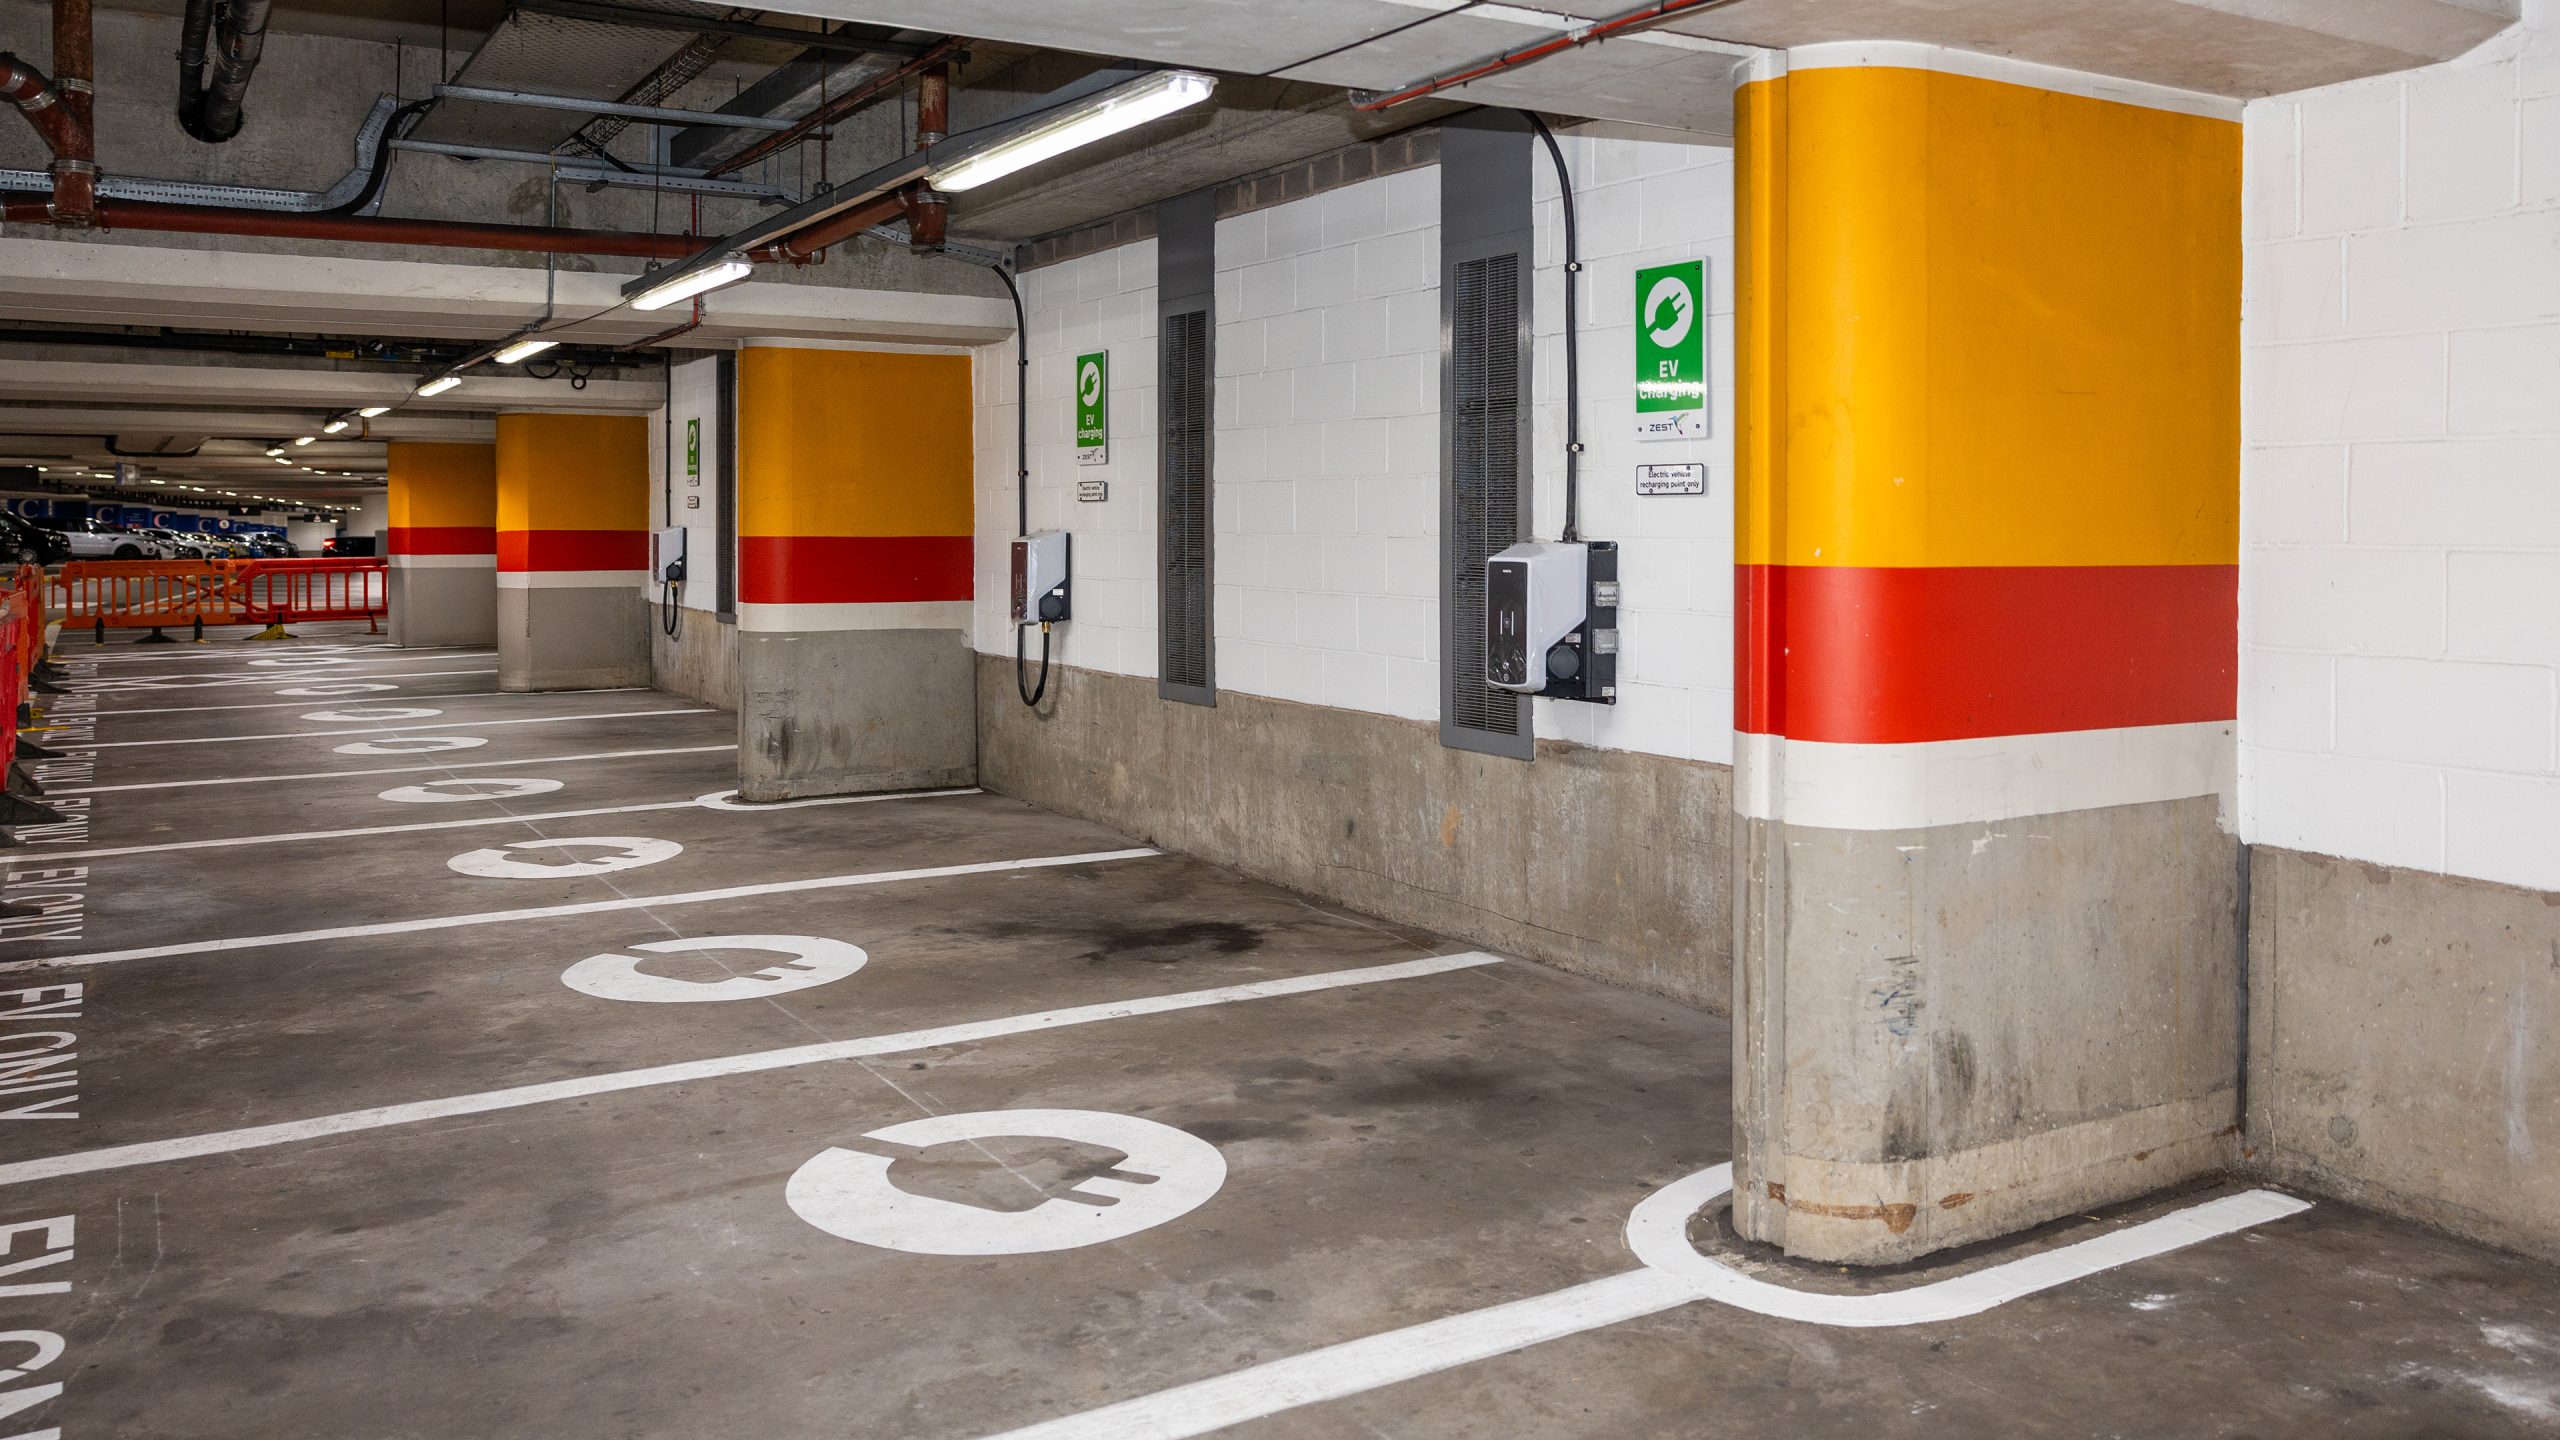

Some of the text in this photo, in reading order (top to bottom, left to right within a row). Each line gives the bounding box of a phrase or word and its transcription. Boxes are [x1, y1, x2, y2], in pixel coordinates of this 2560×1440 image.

[1659, 359, 1679, 378] EV
[1085, 414, 1095, 425] EV
[1078, 427, 1102, 440] charging
[1649, 423, 1674, 432] ZEST
[1648, 470, 1669, 478] Electric
[1687, 479, 1699, 488] only
[18, 499, 39, 519] C
[96, 506, 115, 524] C
[154, 513, 170, 528] C
[200, 519, 212, 532] C
[5, 866, 89, 888] EV
[0, 982, 84, 1020] EV
